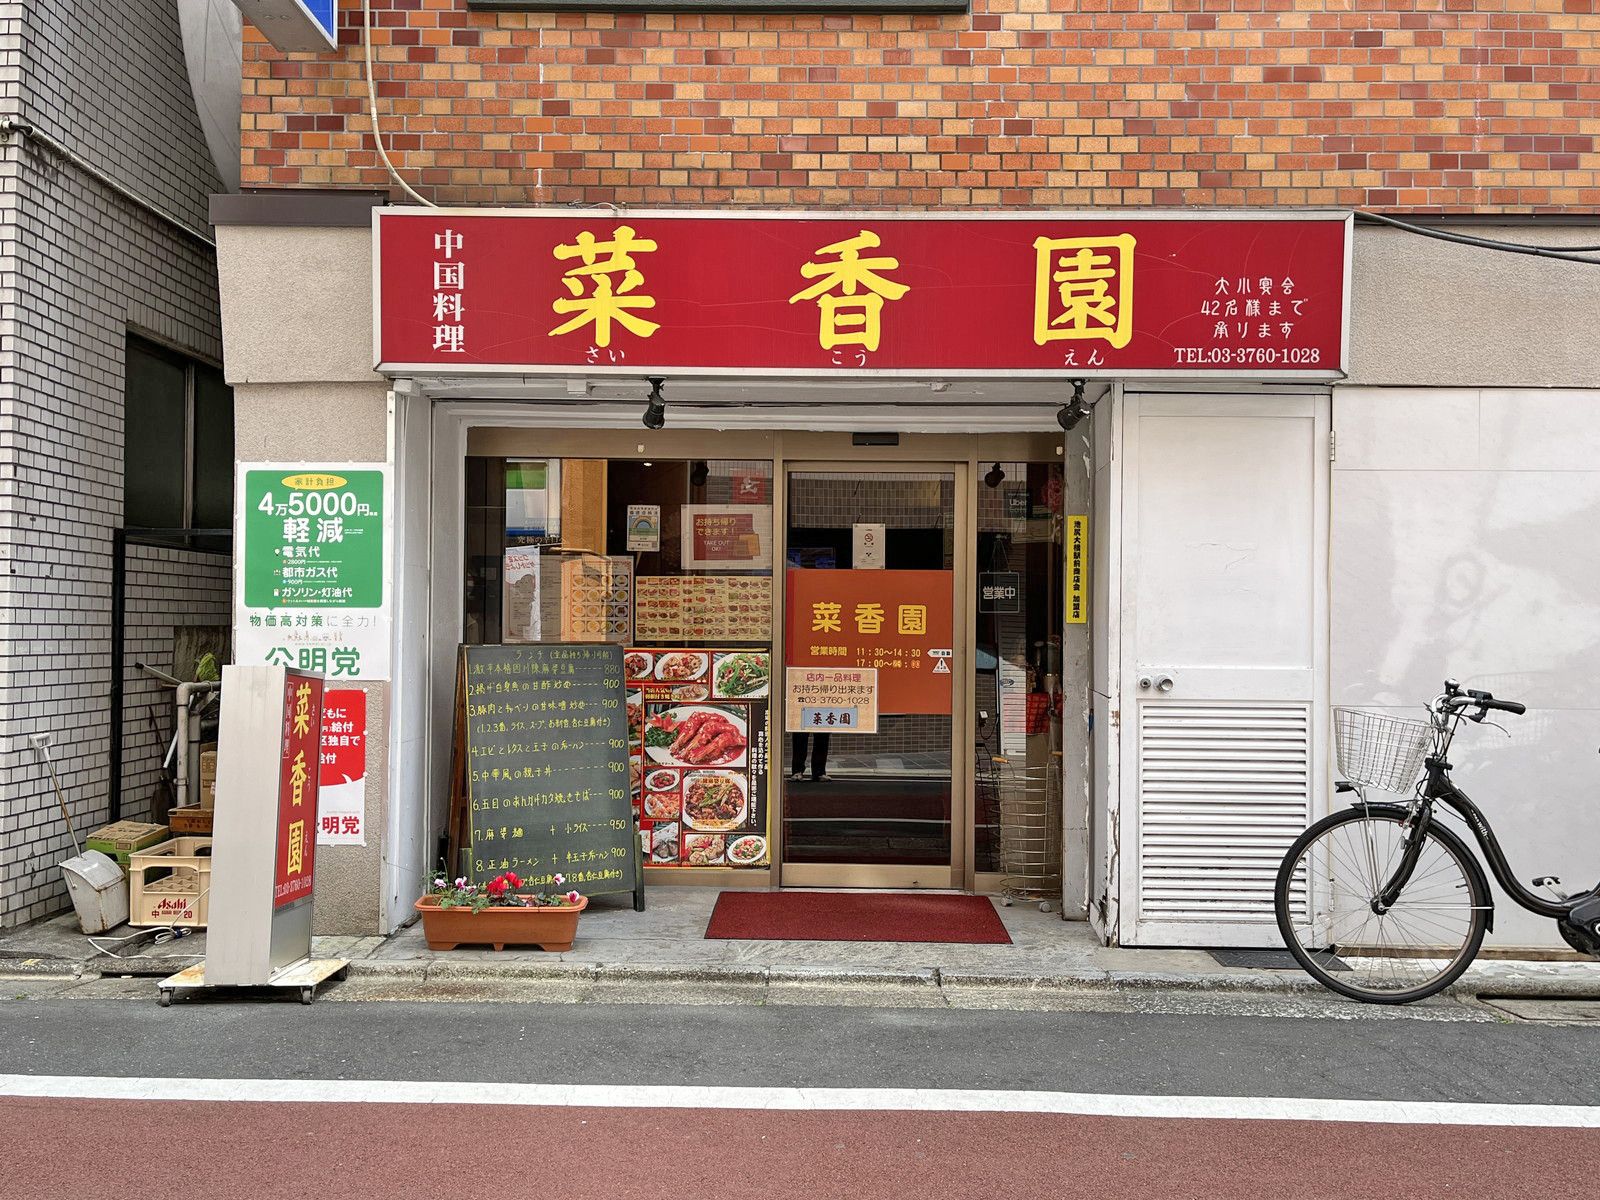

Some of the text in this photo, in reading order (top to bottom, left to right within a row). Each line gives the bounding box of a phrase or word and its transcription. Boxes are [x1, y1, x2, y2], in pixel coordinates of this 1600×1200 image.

[433, 229, 466, 352] 中国料理
[548, 226, 1136, 351] 菜香園
[1215, 276, 1295, 295] 大小宴会
[1200, 298, 1308, 317] 42名様まで
[1213, 321, 1294, 339] 承ります
[585, 346, 1104, 366] さい こう えん
[1174, 347, 1321, 363] TEL:03-3760-1028
[294, 477, 335, 487] 家計負担
[695, 518, 736, 527] お持ち帰り
[282, 517, 344, 543] 軽減
[282, 546, 320, 558] 電気代
[282, 567, 338, 578] 都市ガス代
[282, 587, 353, 598] ガソリン・灯油代
[983, 586, 1016, 600] 営業中
[811, 602, 927, 635] 菜香園
[516, 650, 544, 660] ランチ
[810, 645, 847, 657] 営業時間
[264, 646, 361, 677] 公明党
[604, 664, 620, 674] 880
[602, 679, 620, 689] 900
[806, 673, 862, 683] 店内一品料理
[792, 684, 875, 694] お持ち帰り出来ます
[601, 699, 618, 709] 900
[812, 712, 850, 726] 菜香園
[608, 738, 625, 749] 900
[607, 761, 625, 773] 900
[287, 681, 311, 876] 菜香園
[608, 789, 625, 800] 900
[316, 815, 360, 835] 明党
[609, 819, 626, 830] 950
[610, 847, 627, 858] 900
[157, 898, 187, 909] Asahi
[152, 910, 159, 918] 中
[184, 910, 193, 918] 20
